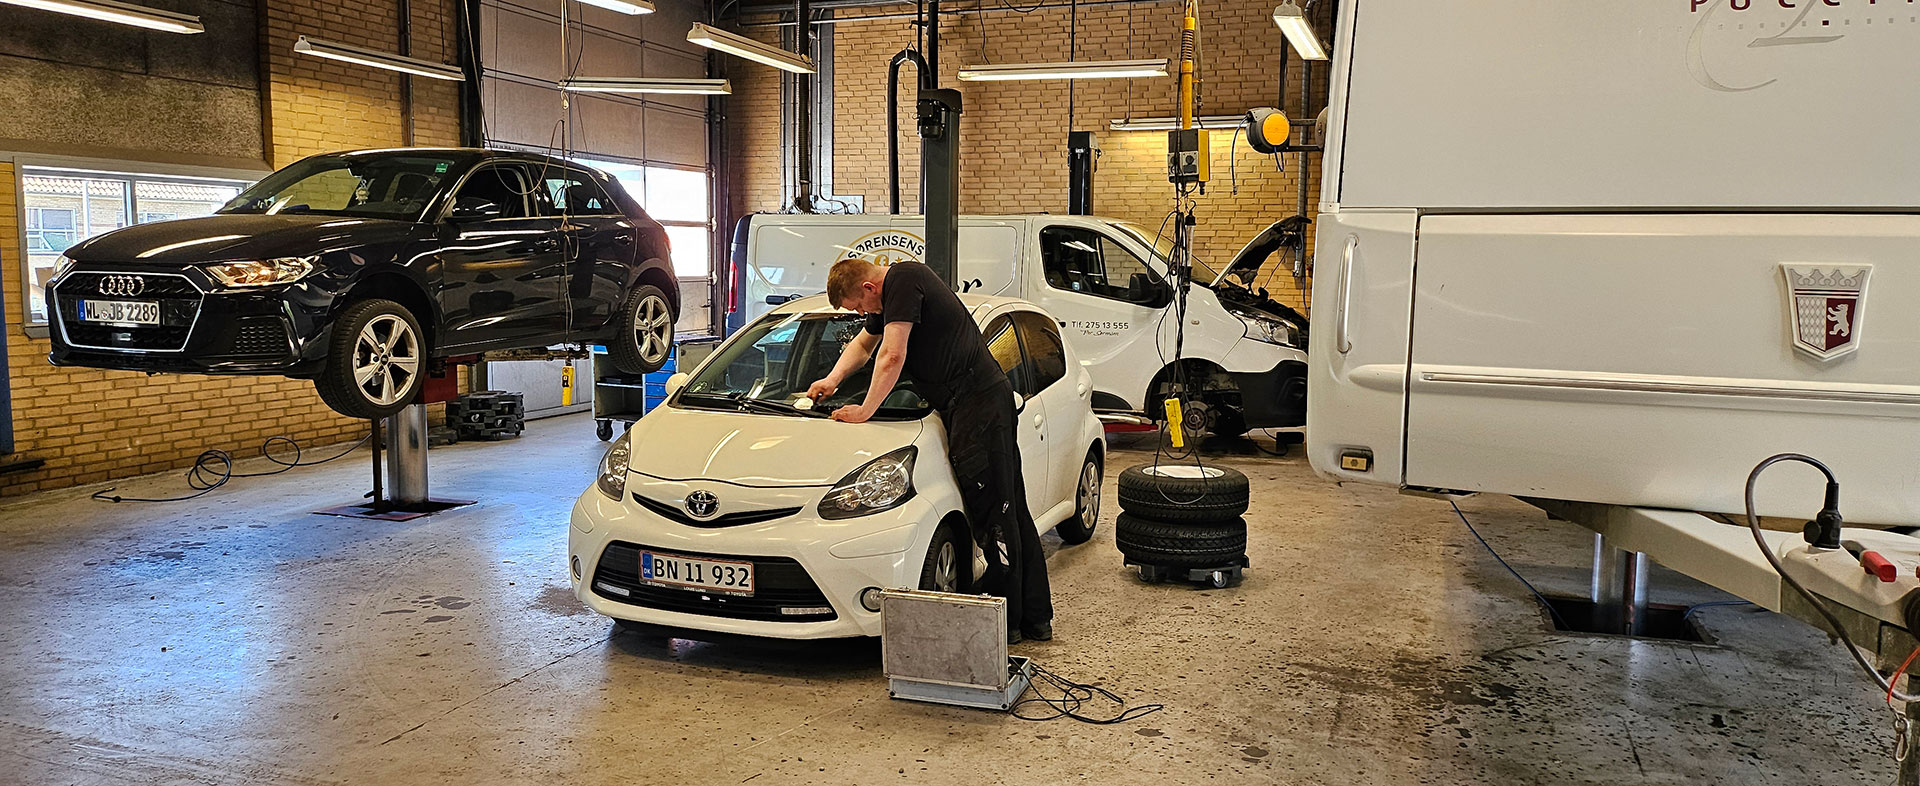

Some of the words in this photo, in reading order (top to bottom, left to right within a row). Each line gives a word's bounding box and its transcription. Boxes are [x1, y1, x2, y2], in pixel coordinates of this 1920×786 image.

[847, 234, 925, 259] SØRENSENS
[85, 301, 100, 319] WL
[108, 302, 124, 321] JB
[126, 303, 158, 322] 2289
[1085, 321, 1101, 329] 275
[1103, 321, 1111, 329] 13
[1113, 322, 1129, 330] 555
[643, 567, 651, 575] DK
[654, 558, 679, 580] BN
[685, 562, 705, 583] 11
[711, 565, 749, 588] 932
